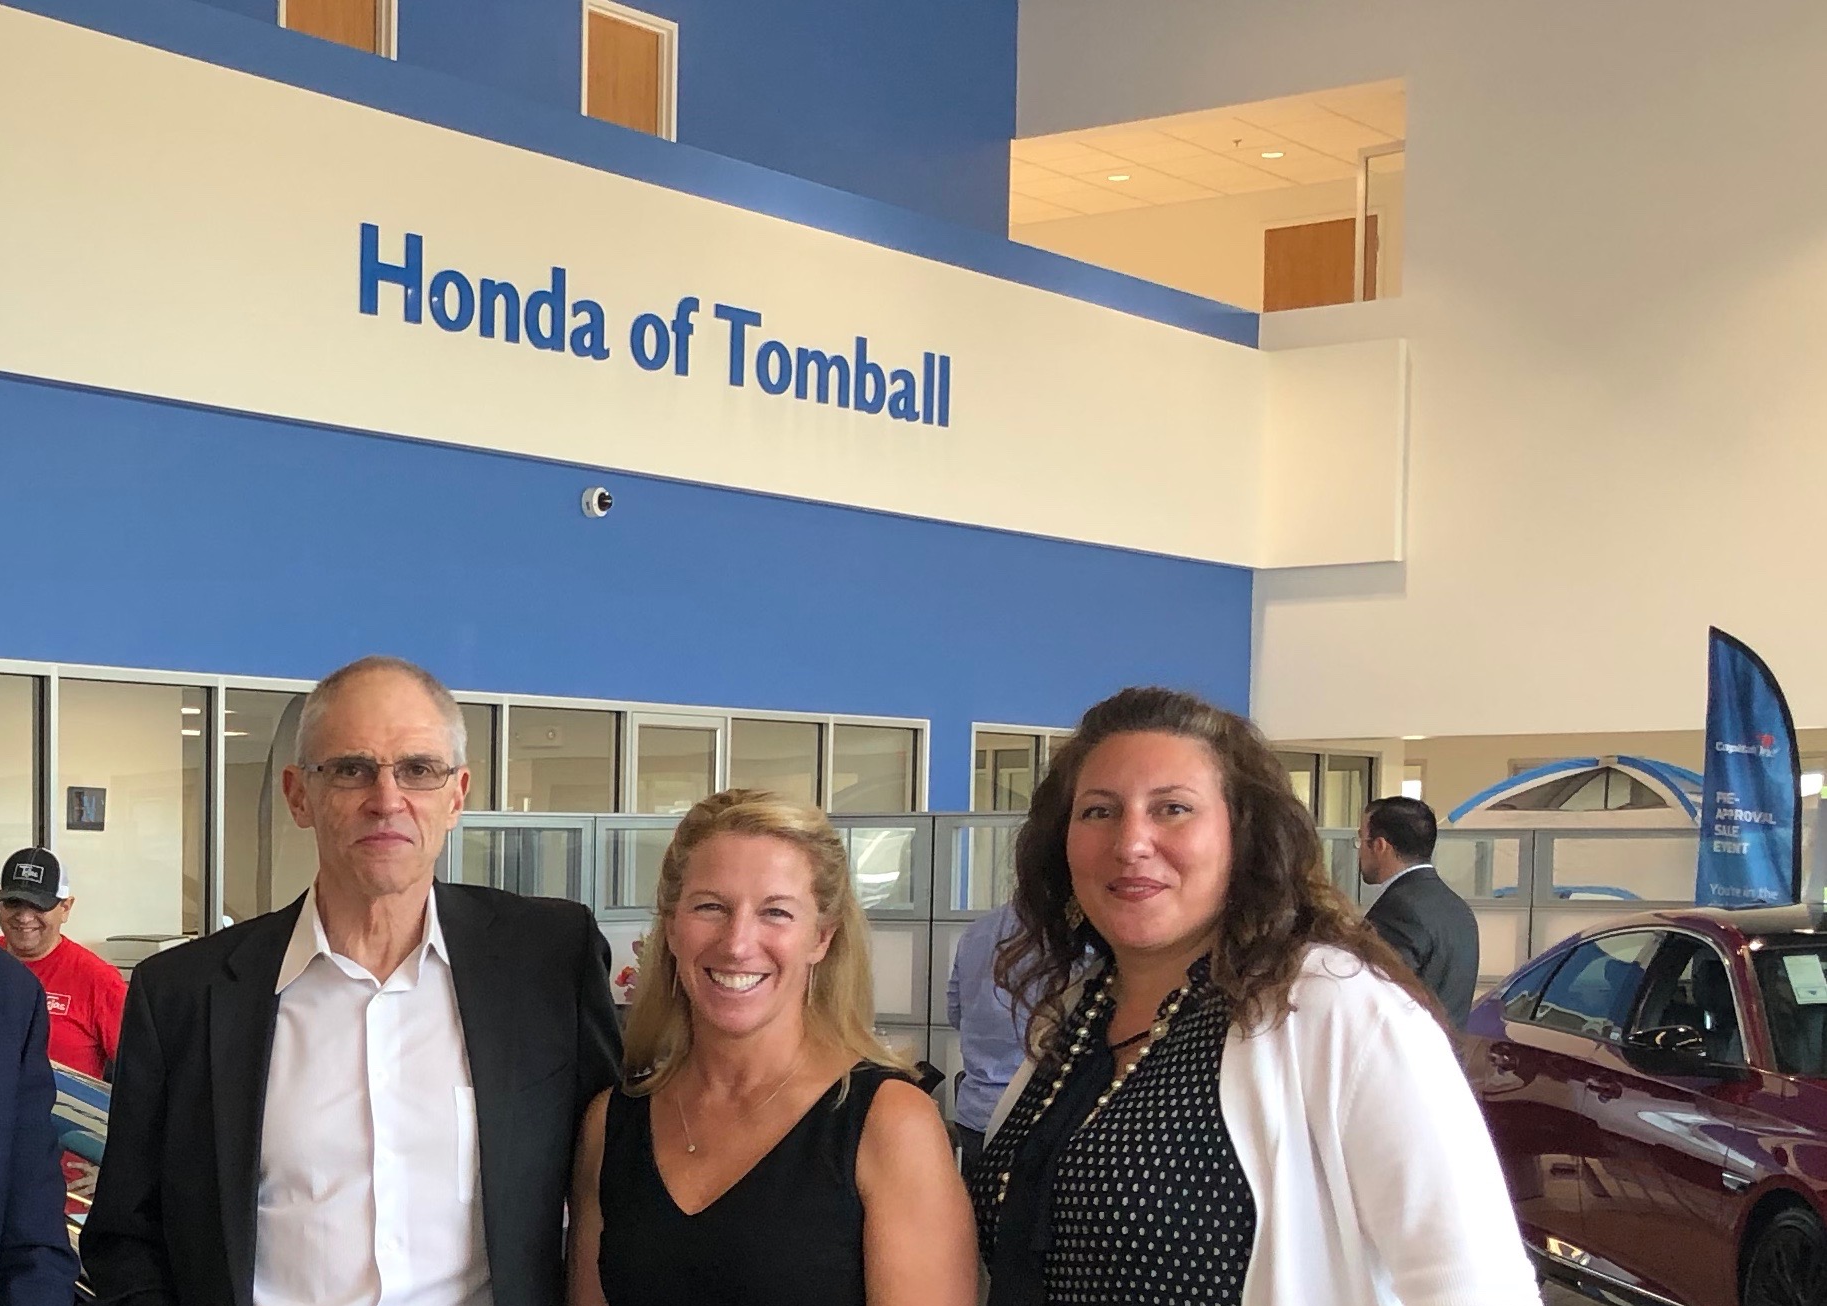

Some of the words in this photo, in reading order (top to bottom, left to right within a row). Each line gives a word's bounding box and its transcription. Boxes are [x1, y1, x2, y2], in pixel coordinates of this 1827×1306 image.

[359, 222, 611, 361] Honda
[630, 296, 700, 377] of
[714, 303, 951, 428] Tomball
